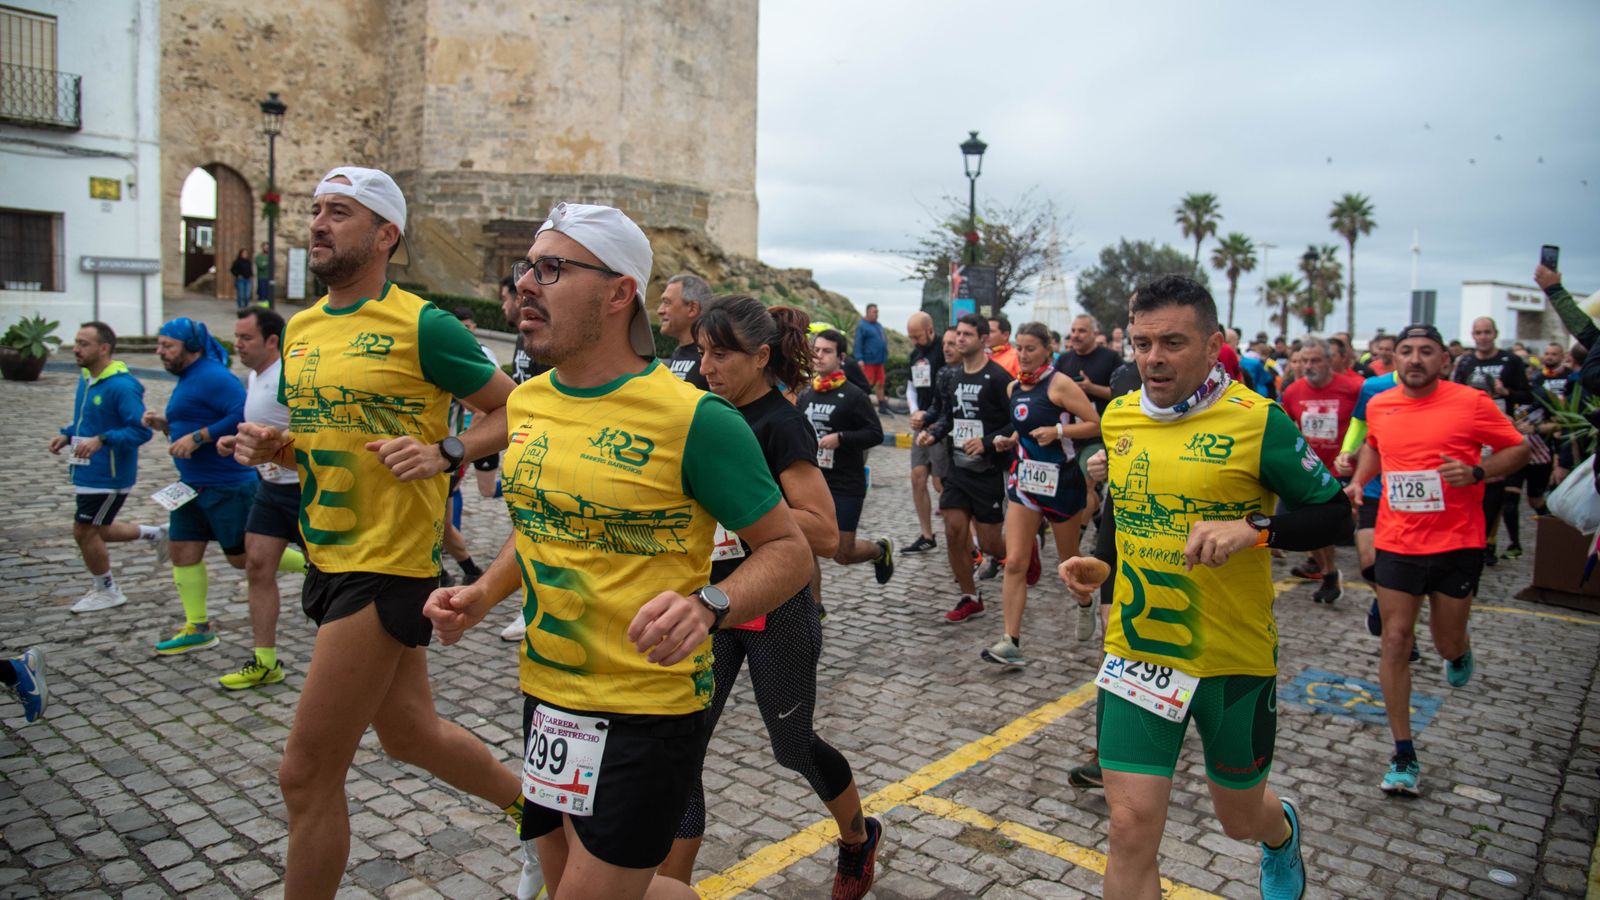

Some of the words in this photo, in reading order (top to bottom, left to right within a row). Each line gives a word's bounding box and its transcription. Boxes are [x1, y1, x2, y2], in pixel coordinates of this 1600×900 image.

[962, 383, 983, 395] XIV
[814, 403, 836, 415] XIV
[1028, 469, 1048, 484] 140
[1397, 481, 1426, 499] 128
[1125, 660, 1174, 690] 298
[545, 714, 580, 730] CARRERA
[543, 725, 558, 736] DEL
[558, 729, 600, 743] ESTRECHO
[528, 728, 568, 775] 299
